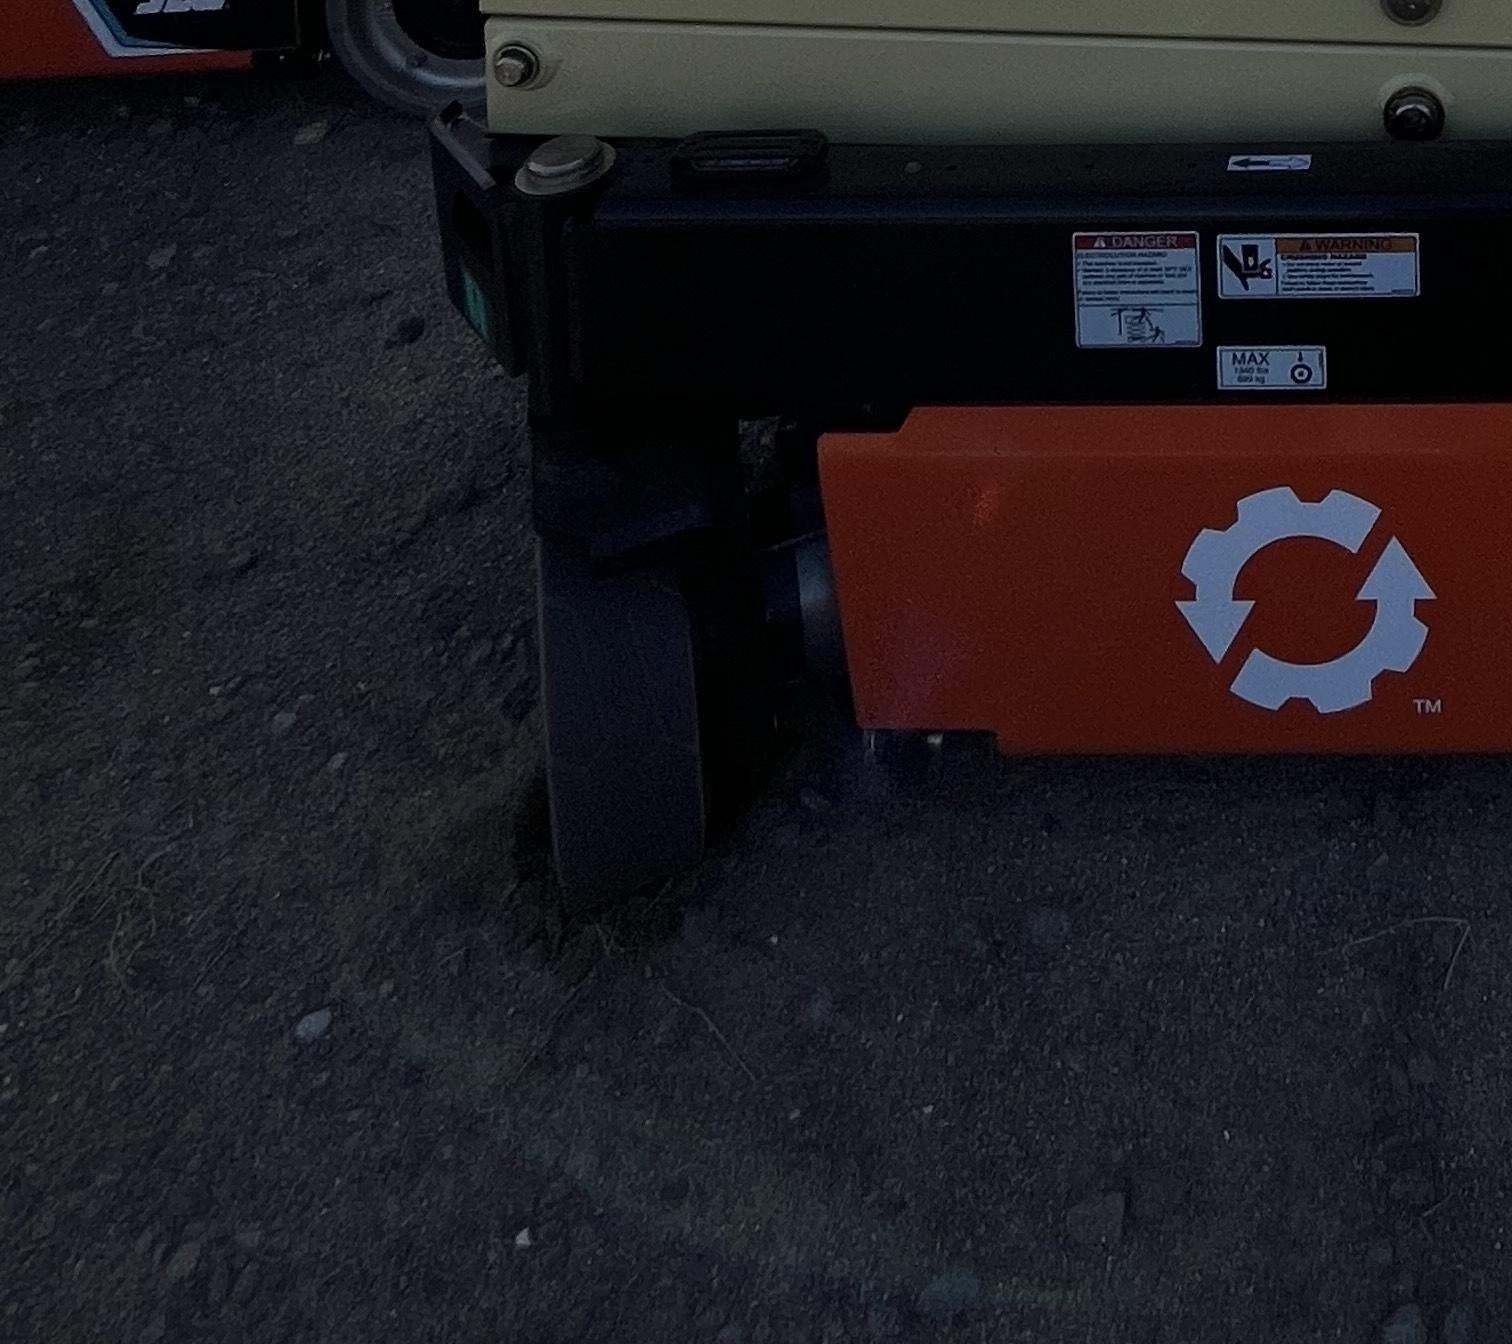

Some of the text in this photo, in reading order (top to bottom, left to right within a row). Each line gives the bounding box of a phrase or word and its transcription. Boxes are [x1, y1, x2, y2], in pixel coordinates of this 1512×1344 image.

[1112, 236, 1178, 248] DANGER
[1317, 239, 1392, 251] WARNING
[1232, 353, 1270, 366] MAX
[1413, 699, 1442, 714] TM
